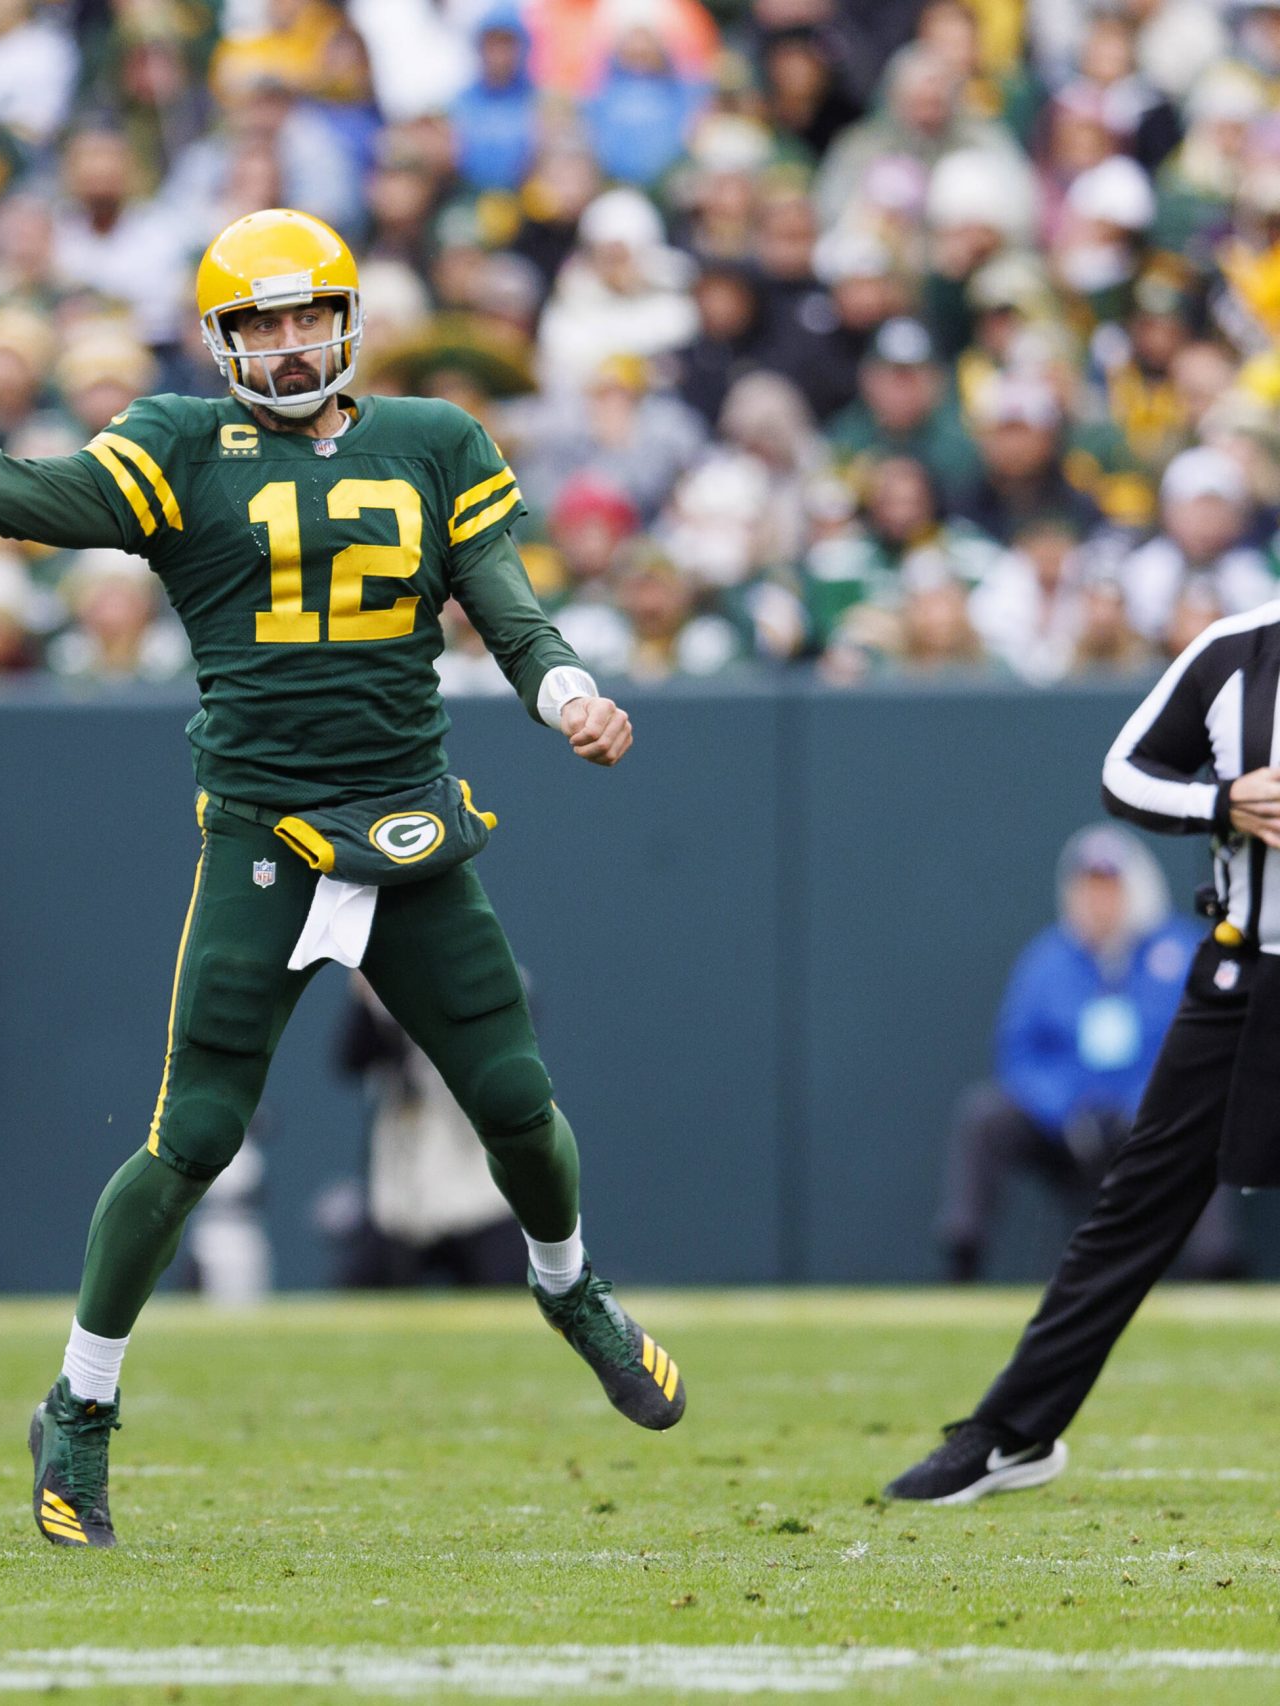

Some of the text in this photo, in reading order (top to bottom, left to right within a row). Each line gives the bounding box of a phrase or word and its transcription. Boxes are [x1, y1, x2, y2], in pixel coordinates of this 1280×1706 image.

[220, 424, 259, 449] C
[248, 478, 423, 643] 12
[375, 815, 437, 857] G
